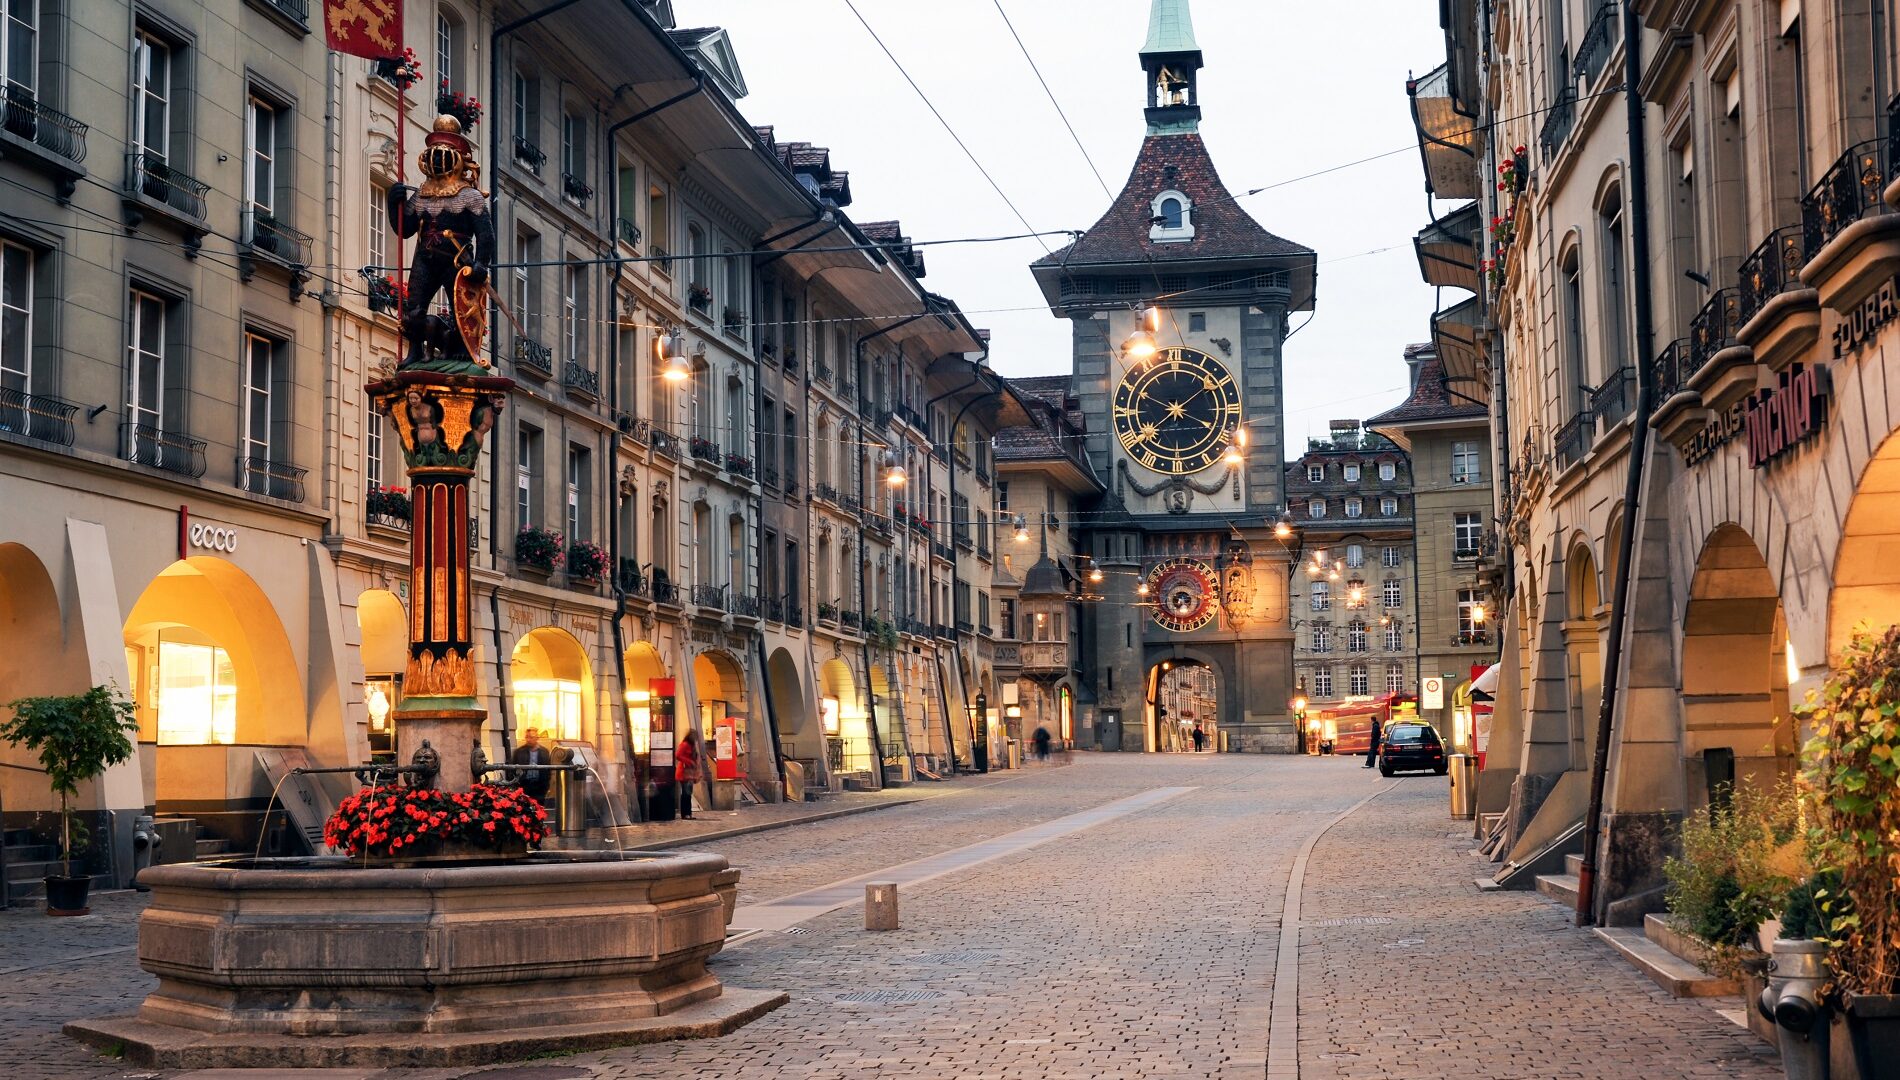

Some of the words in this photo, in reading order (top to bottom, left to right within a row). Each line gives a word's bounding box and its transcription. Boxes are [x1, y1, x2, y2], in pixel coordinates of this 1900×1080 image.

[1167, 349, 1182, 362] XII
[1227, 402, 1241, 414] III
[1681, 400, 1744, 468] PELZHAUS
[190, 523, 238, 553] ecco
